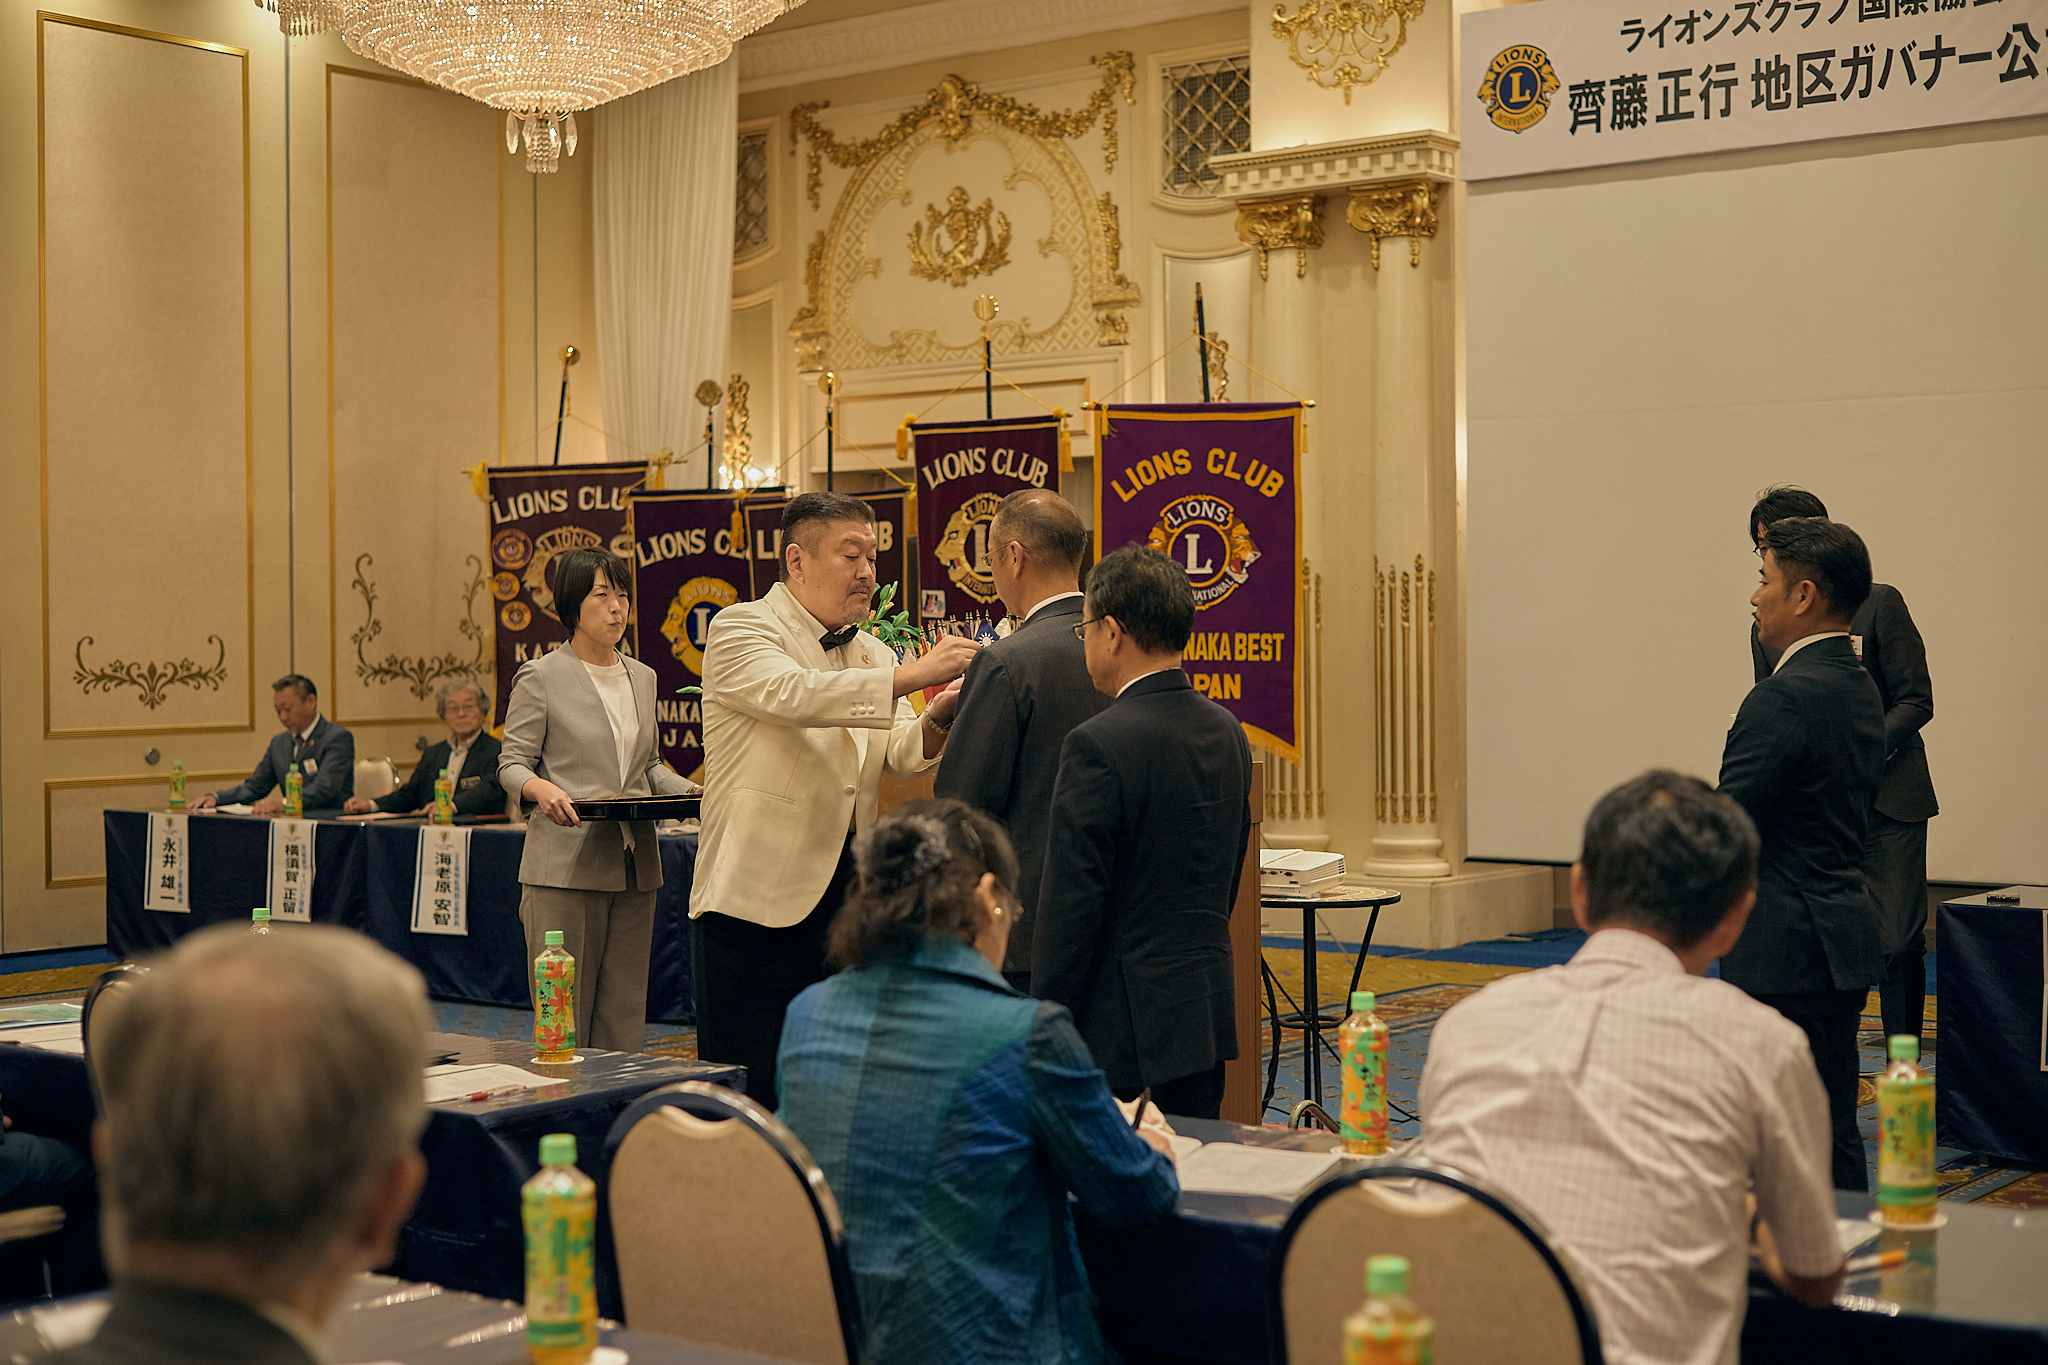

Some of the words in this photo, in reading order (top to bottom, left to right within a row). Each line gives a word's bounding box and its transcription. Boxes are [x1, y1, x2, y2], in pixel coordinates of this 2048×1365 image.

[1495, 49, 1543, 68] LIONS
[1751, 22, 2048, 111] 地区ガバナー公
[1509, 72, 1532, 104] L
[922, 447, 987, 490] LIONS
[991, 448, 1049, 488] CLUB
[1110, 448, 1192, 503] LIONS
[1206, 447, 1285, 498] CLUB
[491, 489, 569, 525] LIONS
[578, 486, 628, 512] CLU
[966, 499, 999, 520] LION
[1166, 501, 1228, 526] LIONS
[540, 531, 599, 551] LIONS
[635, 527, 707, 568] LIONS
[1184, 533, 1213, 574] L
[685, 583, 732, 604] LIONS
[1183, 632, 1232, 661] NAKA
[1234, 632, 1285, 662] BEST
[1186, 673, 1242, 700] PAN
